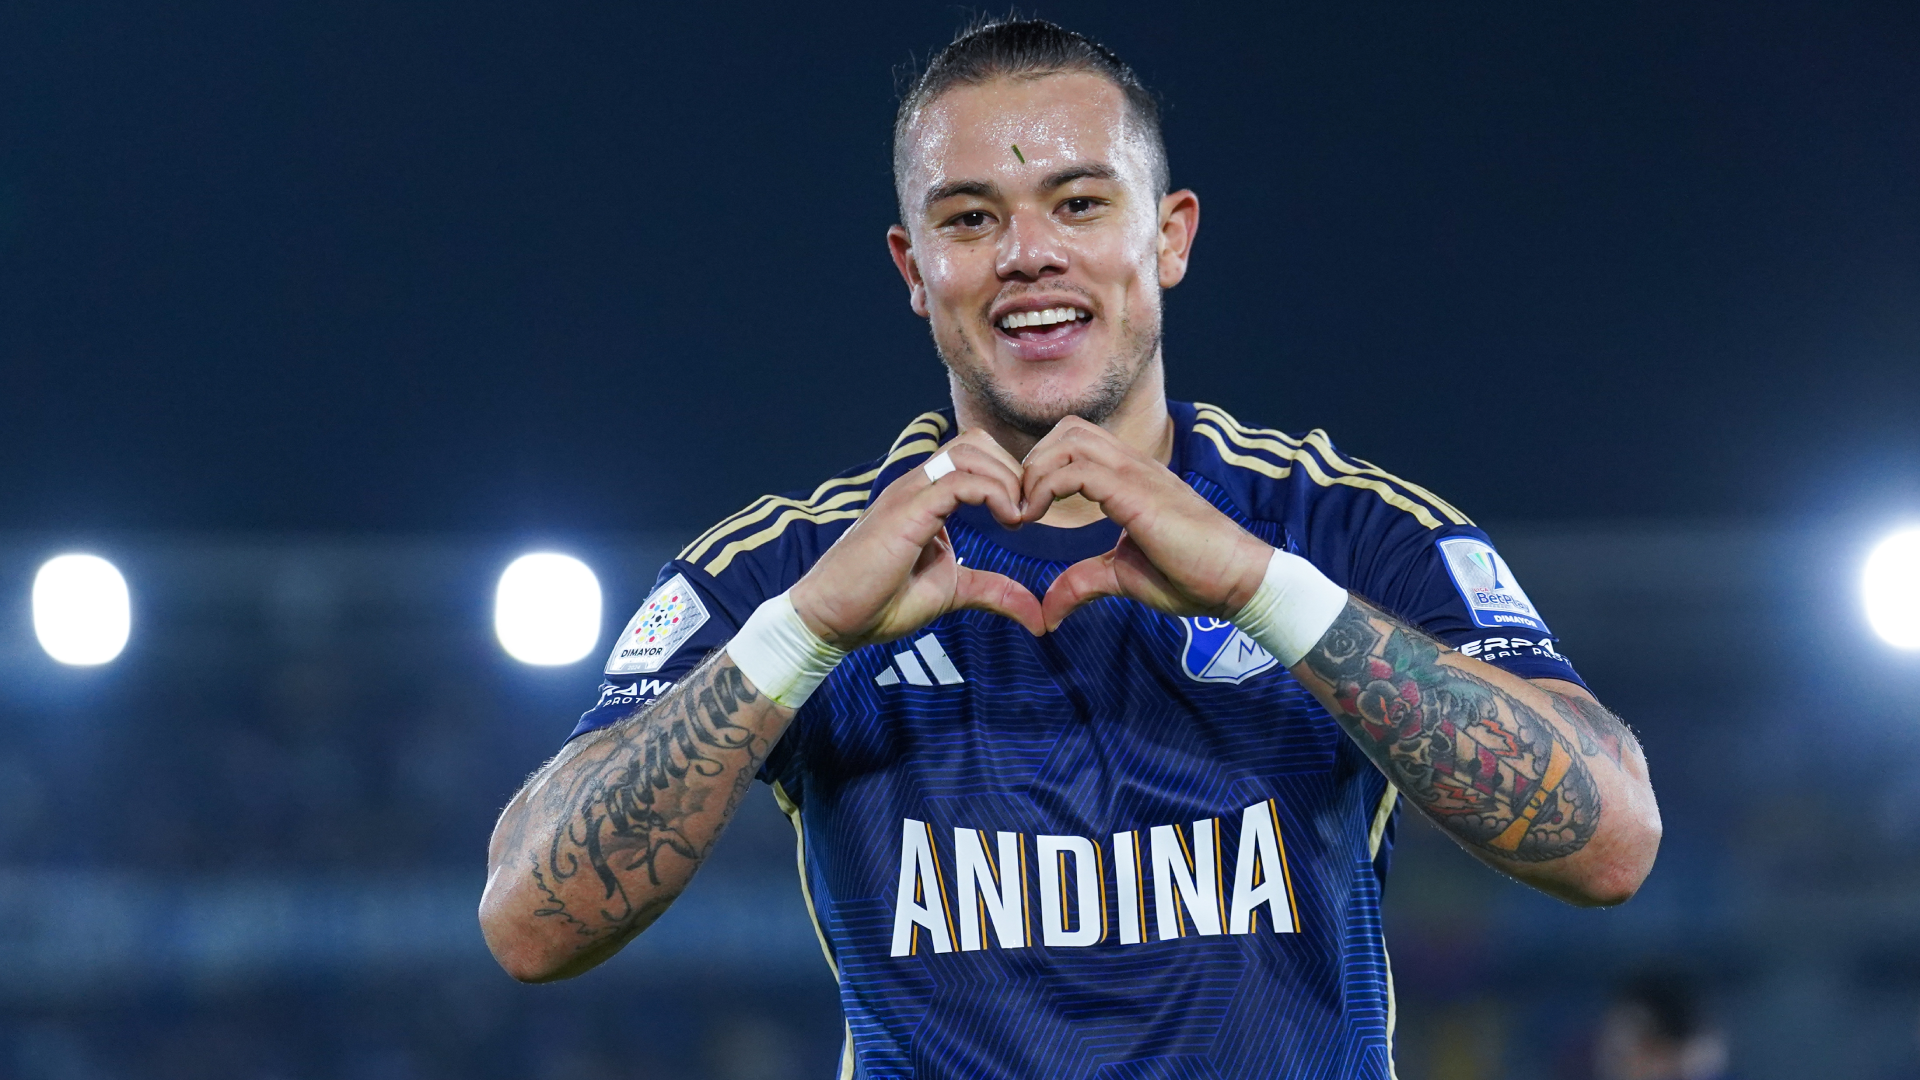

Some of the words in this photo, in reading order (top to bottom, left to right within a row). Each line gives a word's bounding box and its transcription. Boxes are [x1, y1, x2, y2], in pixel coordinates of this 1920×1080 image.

[1477, 592, 1530, 613] BetPlay
[1494, 615, 1538, 628] DIMAYOR
[621, 647, 663, 658] DIMAYOR
[890, 798, 1301, 957] ANDINA
